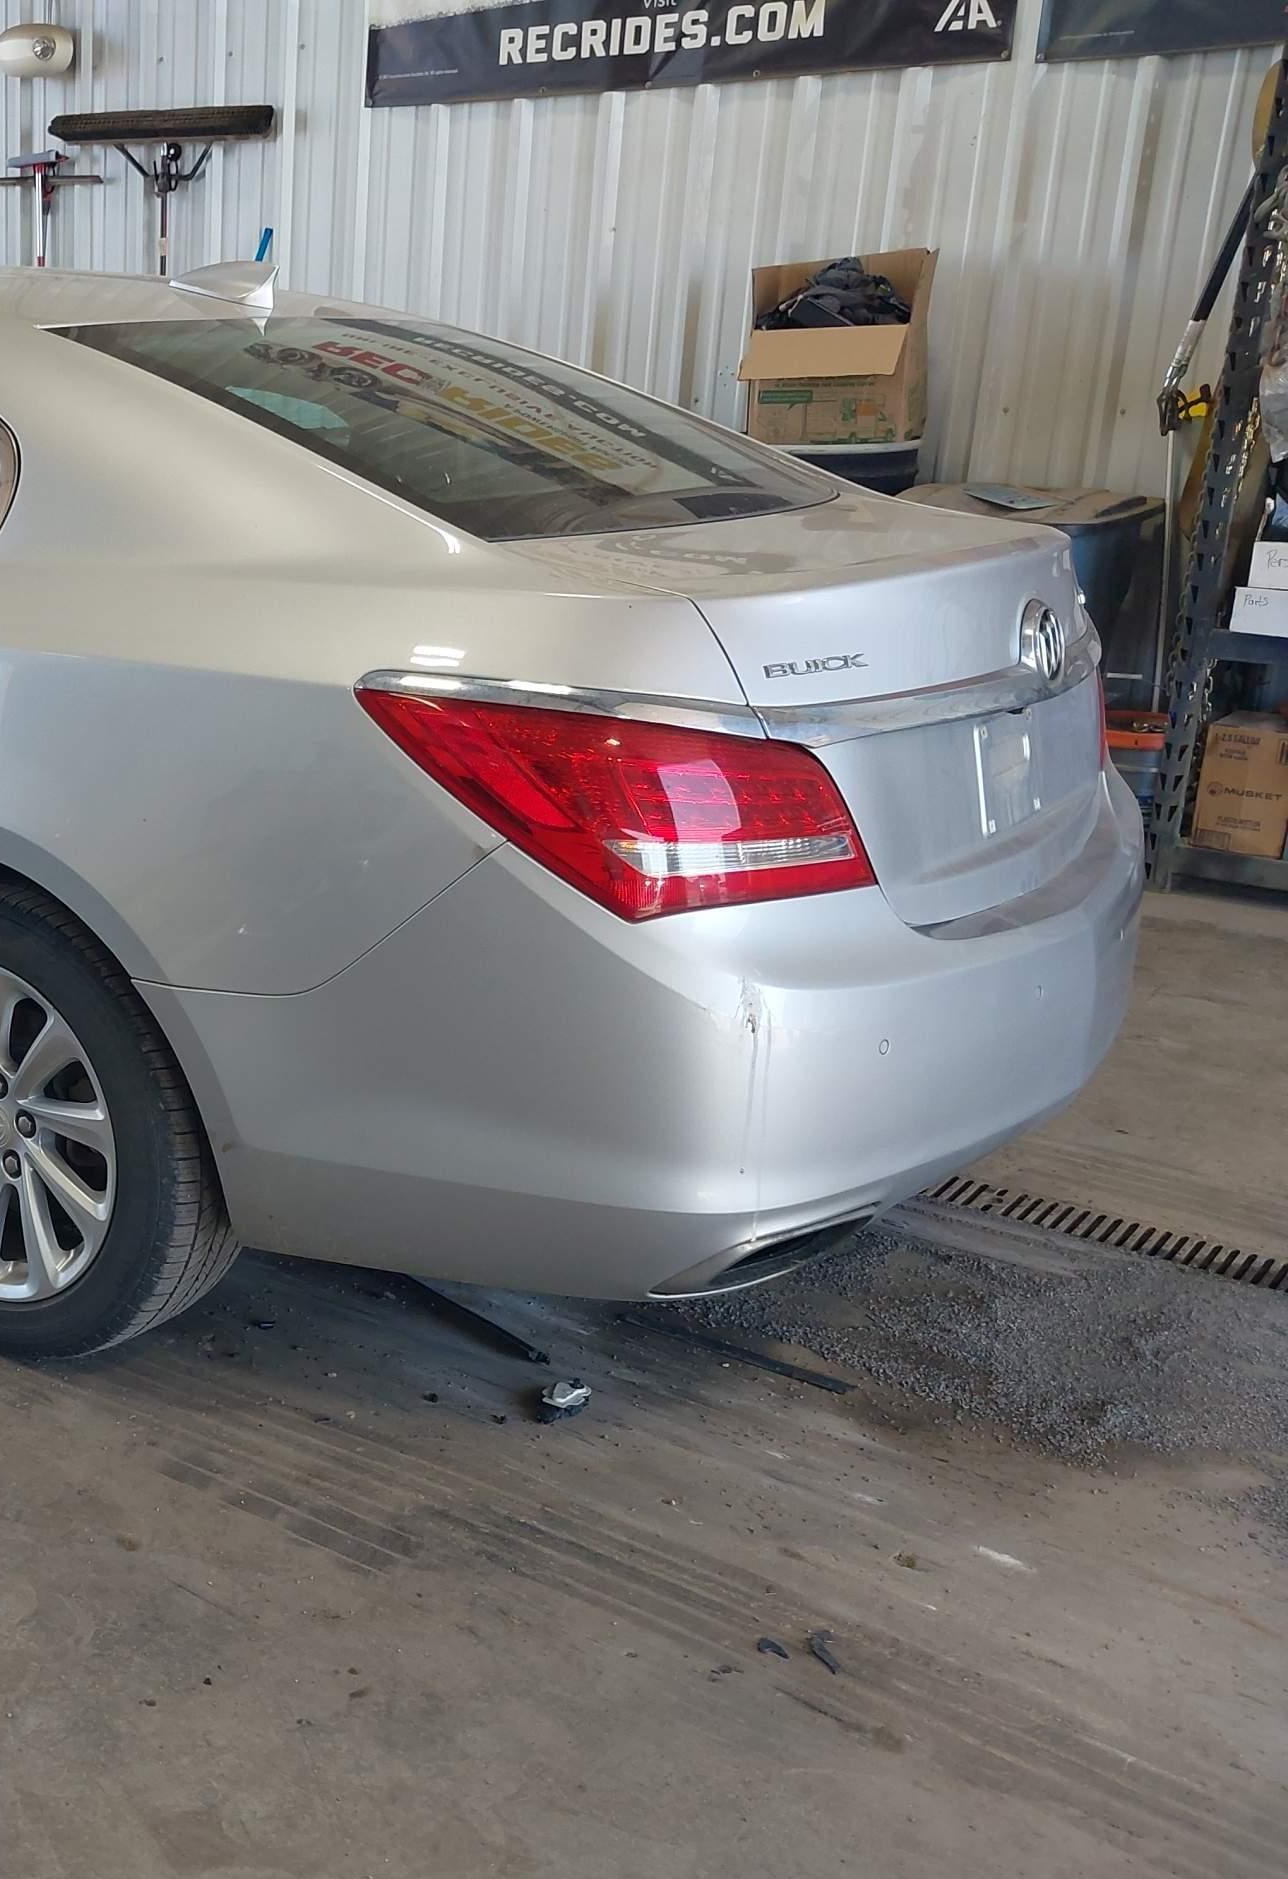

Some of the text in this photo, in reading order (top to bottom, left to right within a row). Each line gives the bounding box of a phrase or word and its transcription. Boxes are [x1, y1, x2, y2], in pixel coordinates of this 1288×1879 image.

[498, 0, 825, 66] RECRIDES.COM
[763, 653, 869, 679] BUICK
[1223, 786, 1283, 801] MUSKET
